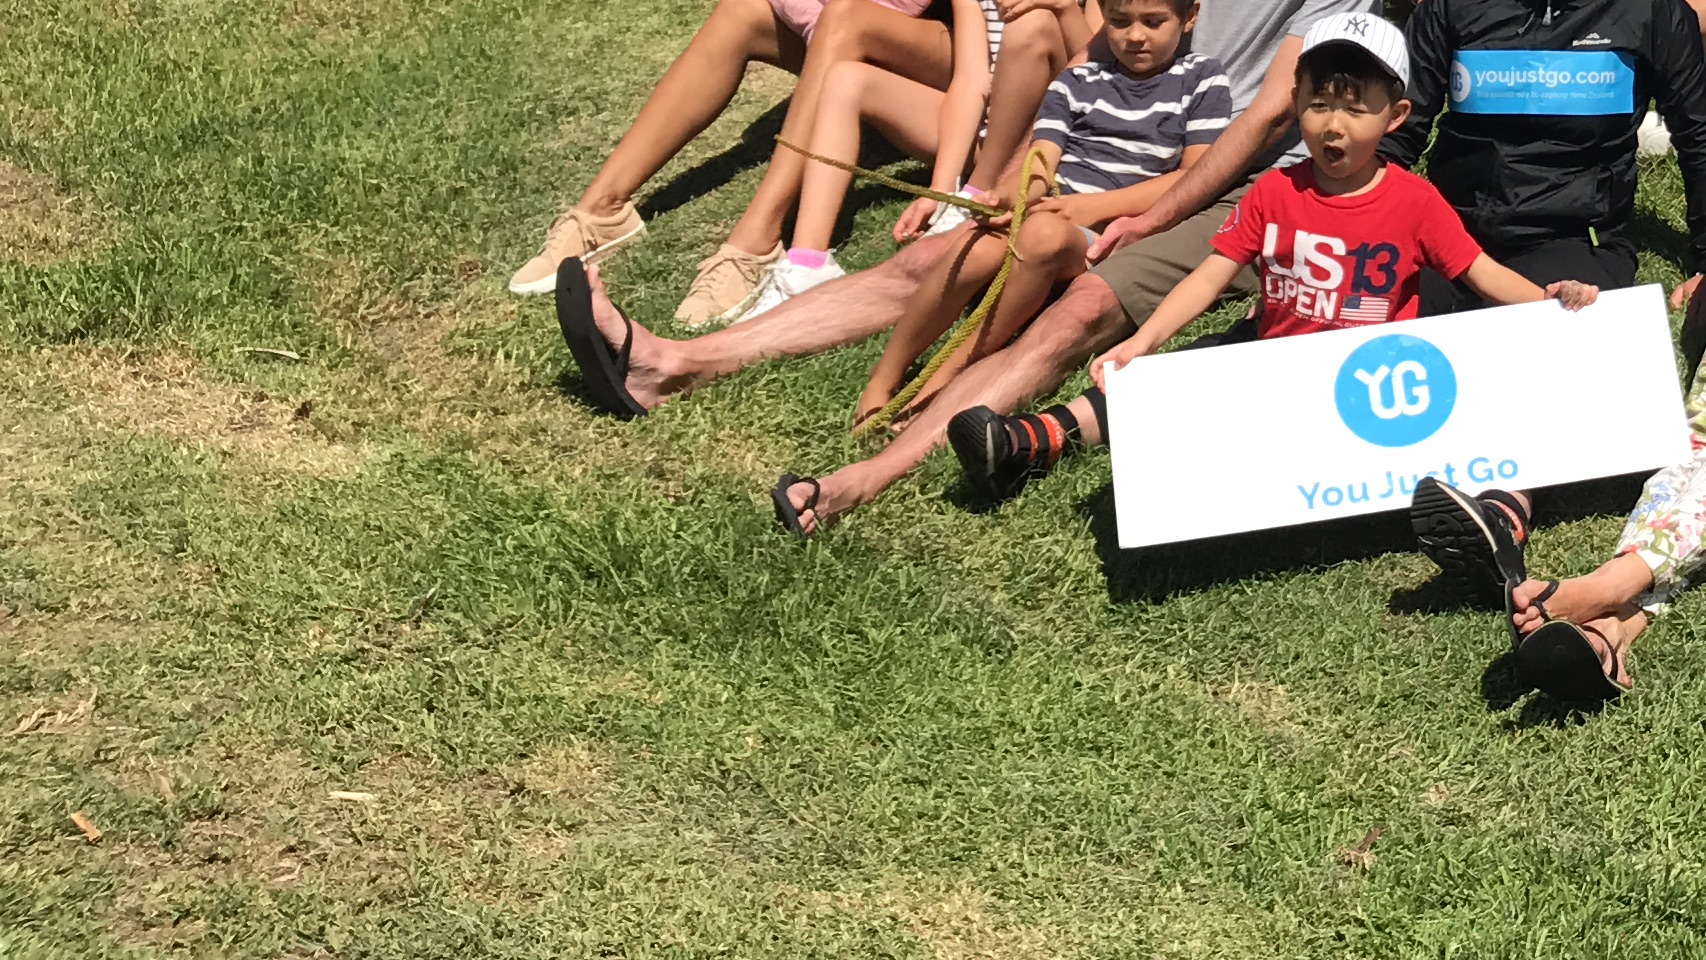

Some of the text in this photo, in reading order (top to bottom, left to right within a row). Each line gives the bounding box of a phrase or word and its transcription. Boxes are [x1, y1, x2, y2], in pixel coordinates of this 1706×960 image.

[1475, 65, 1616, 88] youjustgo.com
[1262, 223, 1400, 296] US 13
[1265, 273, 1338, 321] OPEN
[1296, 456, 1519, 509] You Jut Go
